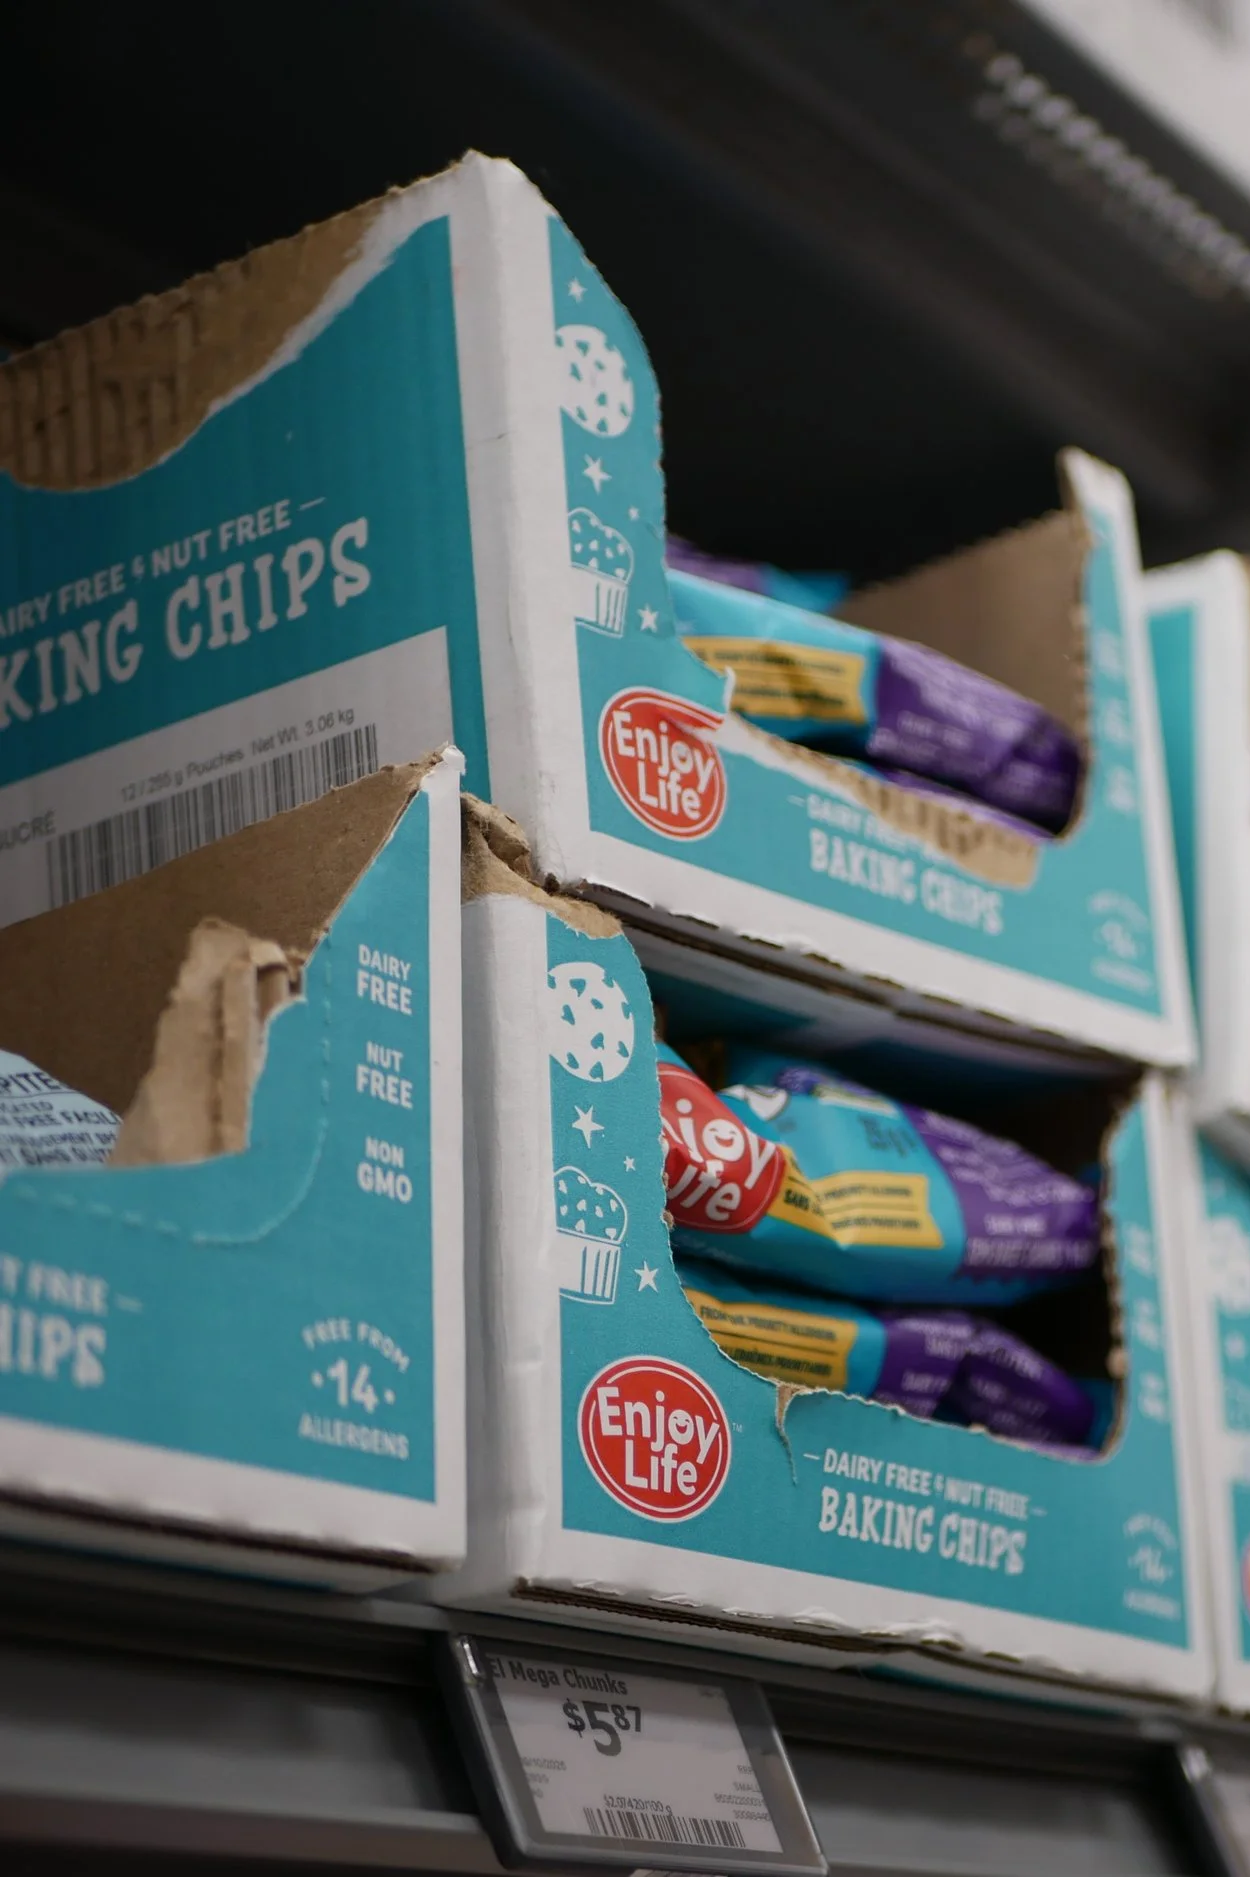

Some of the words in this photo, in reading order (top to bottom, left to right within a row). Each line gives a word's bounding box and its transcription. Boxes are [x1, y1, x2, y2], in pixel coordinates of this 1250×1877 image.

[57, 562, 127, 616] FREE
[151, 528, 213, 578] NUT
[218, 498, 292, 552] FREE
[165, 516, 372, 661] CHIPS
[186, 746, 245, 780] Pouches
[251, 737, 276, 756] Net
[304, 713, 335, 737] 3.06
[337, 707, 355, 726] kg
[612, 709, 715, 794] Enjoy
[636, 769, 701, 821] Life
[809, 826, 918, 905] BAKING
[357, 943, 412, 982] DAIRY
[356, 968, 413, 1016] FREE
[366, 1040, 404, 1073] NUT
[356, 1063, 414, 1110] FREE
[365, 1135, 405, 1169] NON
[357, 1161, 414, 1205] GMO
[301, 1317, 352, 1351] FREE
[356, 1321, 411, 1373] FROM
[299, 1411, 410, 1462] ALLERGENS
[597, 1386, 720, 1465] Enjoy
[624, 1439, 698, 1496] Life
[822, 1447, 883, 1485] DAIRY
[885, 1462, 933, 1497] FREE
[945, 1476, 985, 1509] NUT
[985, 1484, 1031, 1522] FREE
[818, 1485, 935, 1555] BAKING
[938, 1511, 1027, 1576] CHIPS
[508, 1660, 561, 1689] Mega
[563, 1668, 629, 1696] Chunks
